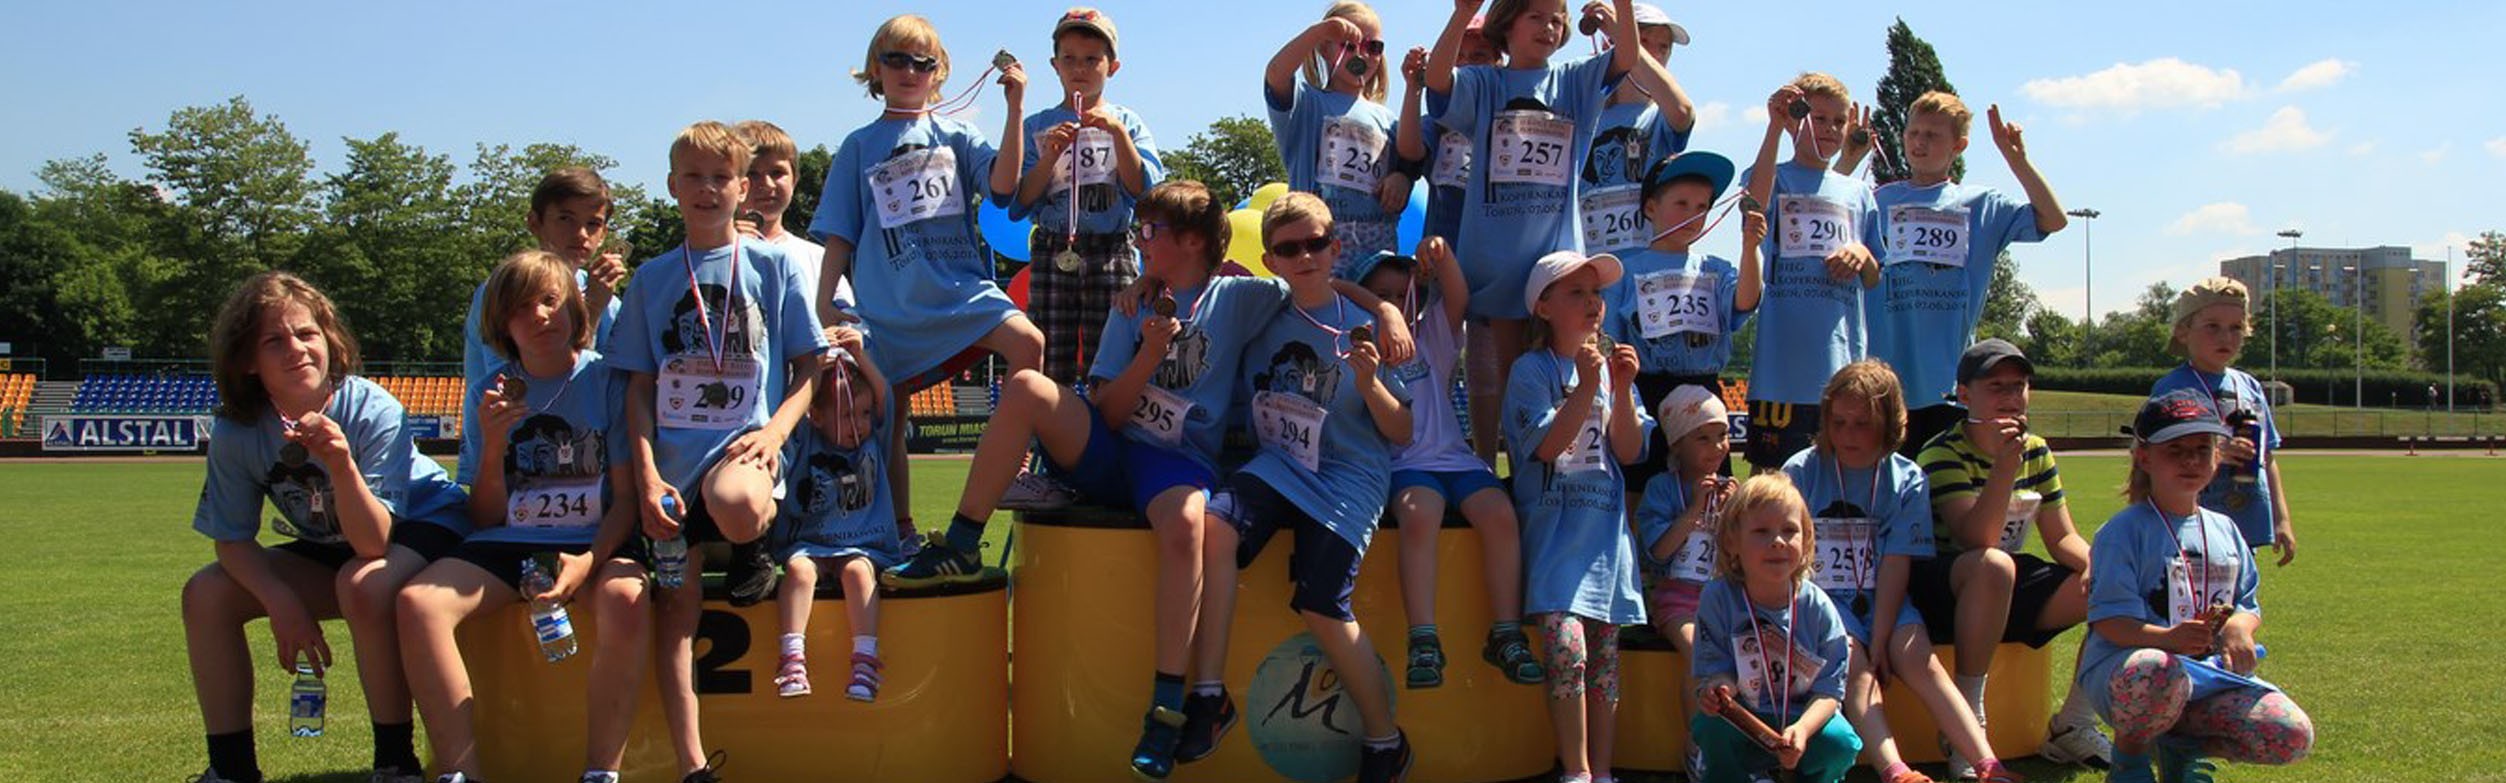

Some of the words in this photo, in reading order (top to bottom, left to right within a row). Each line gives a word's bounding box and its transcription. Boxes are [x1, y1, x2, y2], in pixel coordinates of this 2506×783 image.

[1343, 147, 1382, 179] 236
[1520, 140, 1564, 166] 257
[907, 175, 953, 202] 261
[1604, 210, 1645, 235] 260
[1809, 219, 1848, 244] 290
[1914, 227, 1958, 249] 289
[1667, 295, 1710, 317] 235
[692, 383, 745, 410] 29
[1133, 395, 1175, 432] 295
[79, 420, 188, 446] ALSTAL
[1279, 416, 1310, 450] 294
[537, 493, 589, 518] 234
[695, 609, 753, 694] 2
